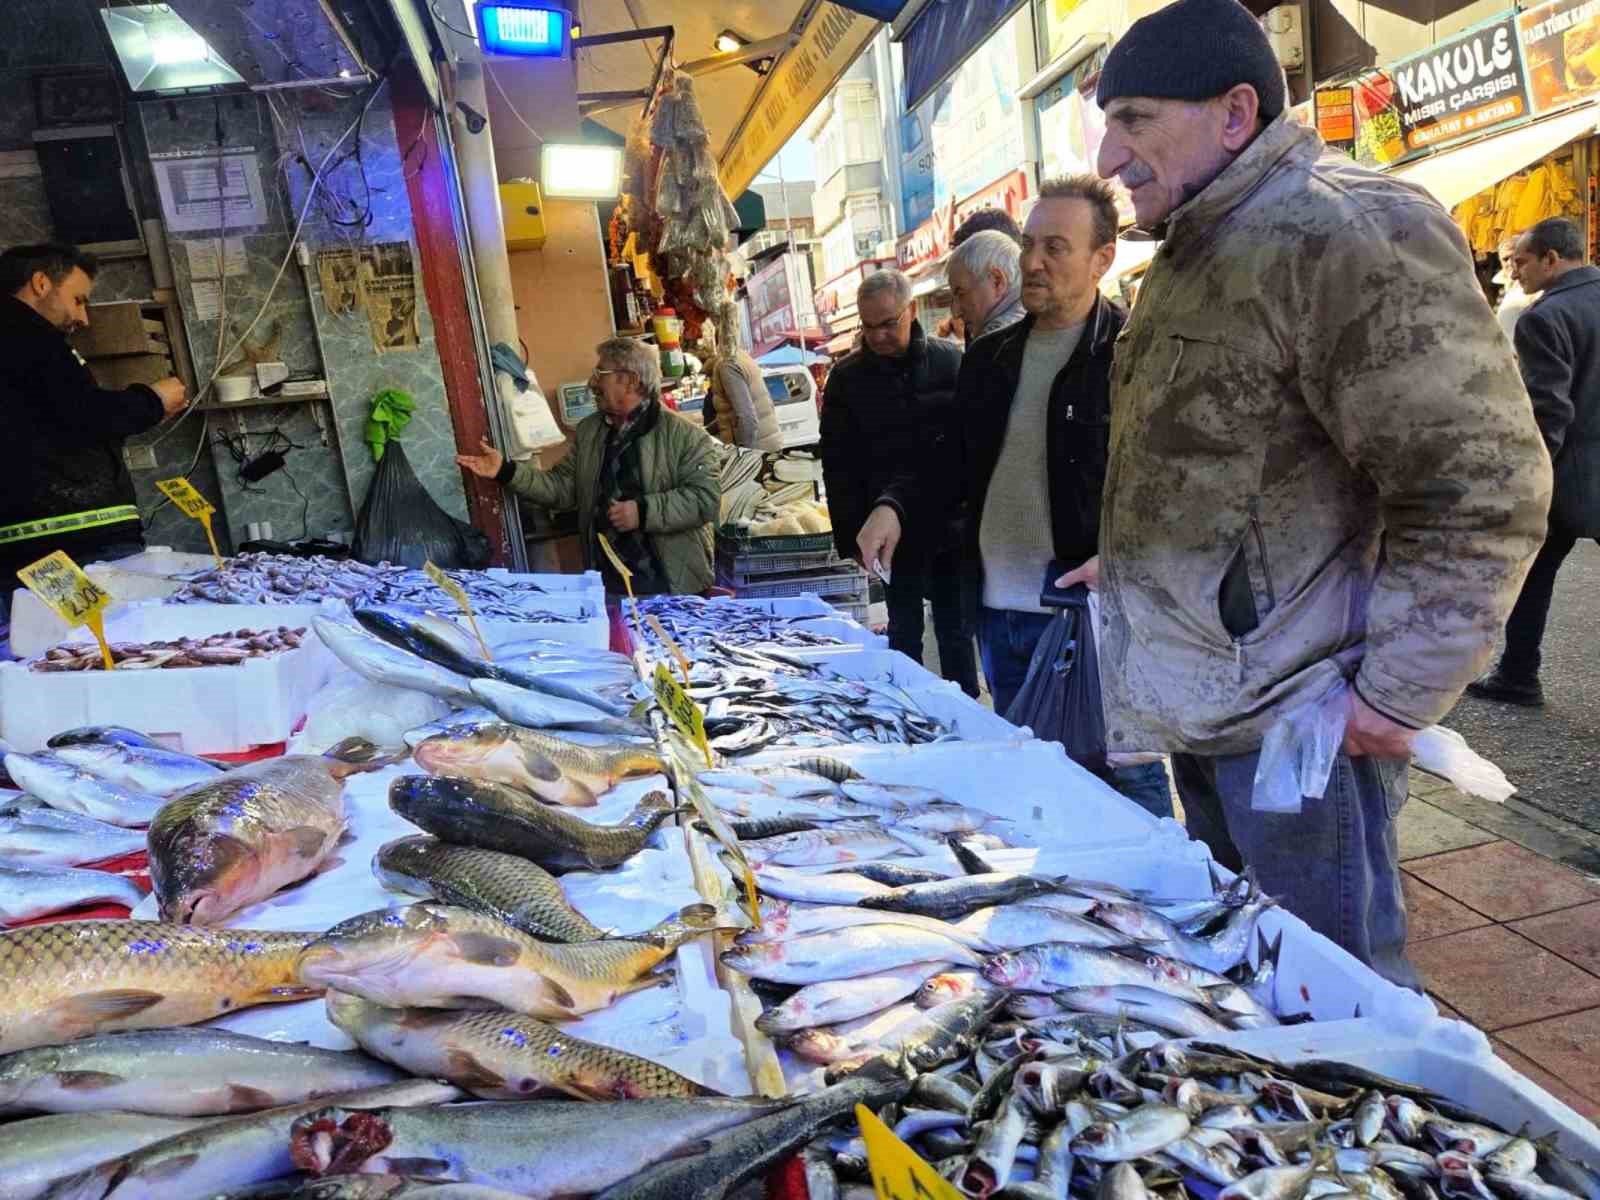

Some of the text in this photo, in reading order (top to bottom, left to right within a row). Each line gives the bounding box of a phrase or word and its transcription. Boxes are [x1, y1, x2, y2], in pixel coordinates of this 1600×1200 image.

[1397, 27, 1513, 107] KAKULE
[1404, 72, 1518, 126] MISIR ÇARŞISI
